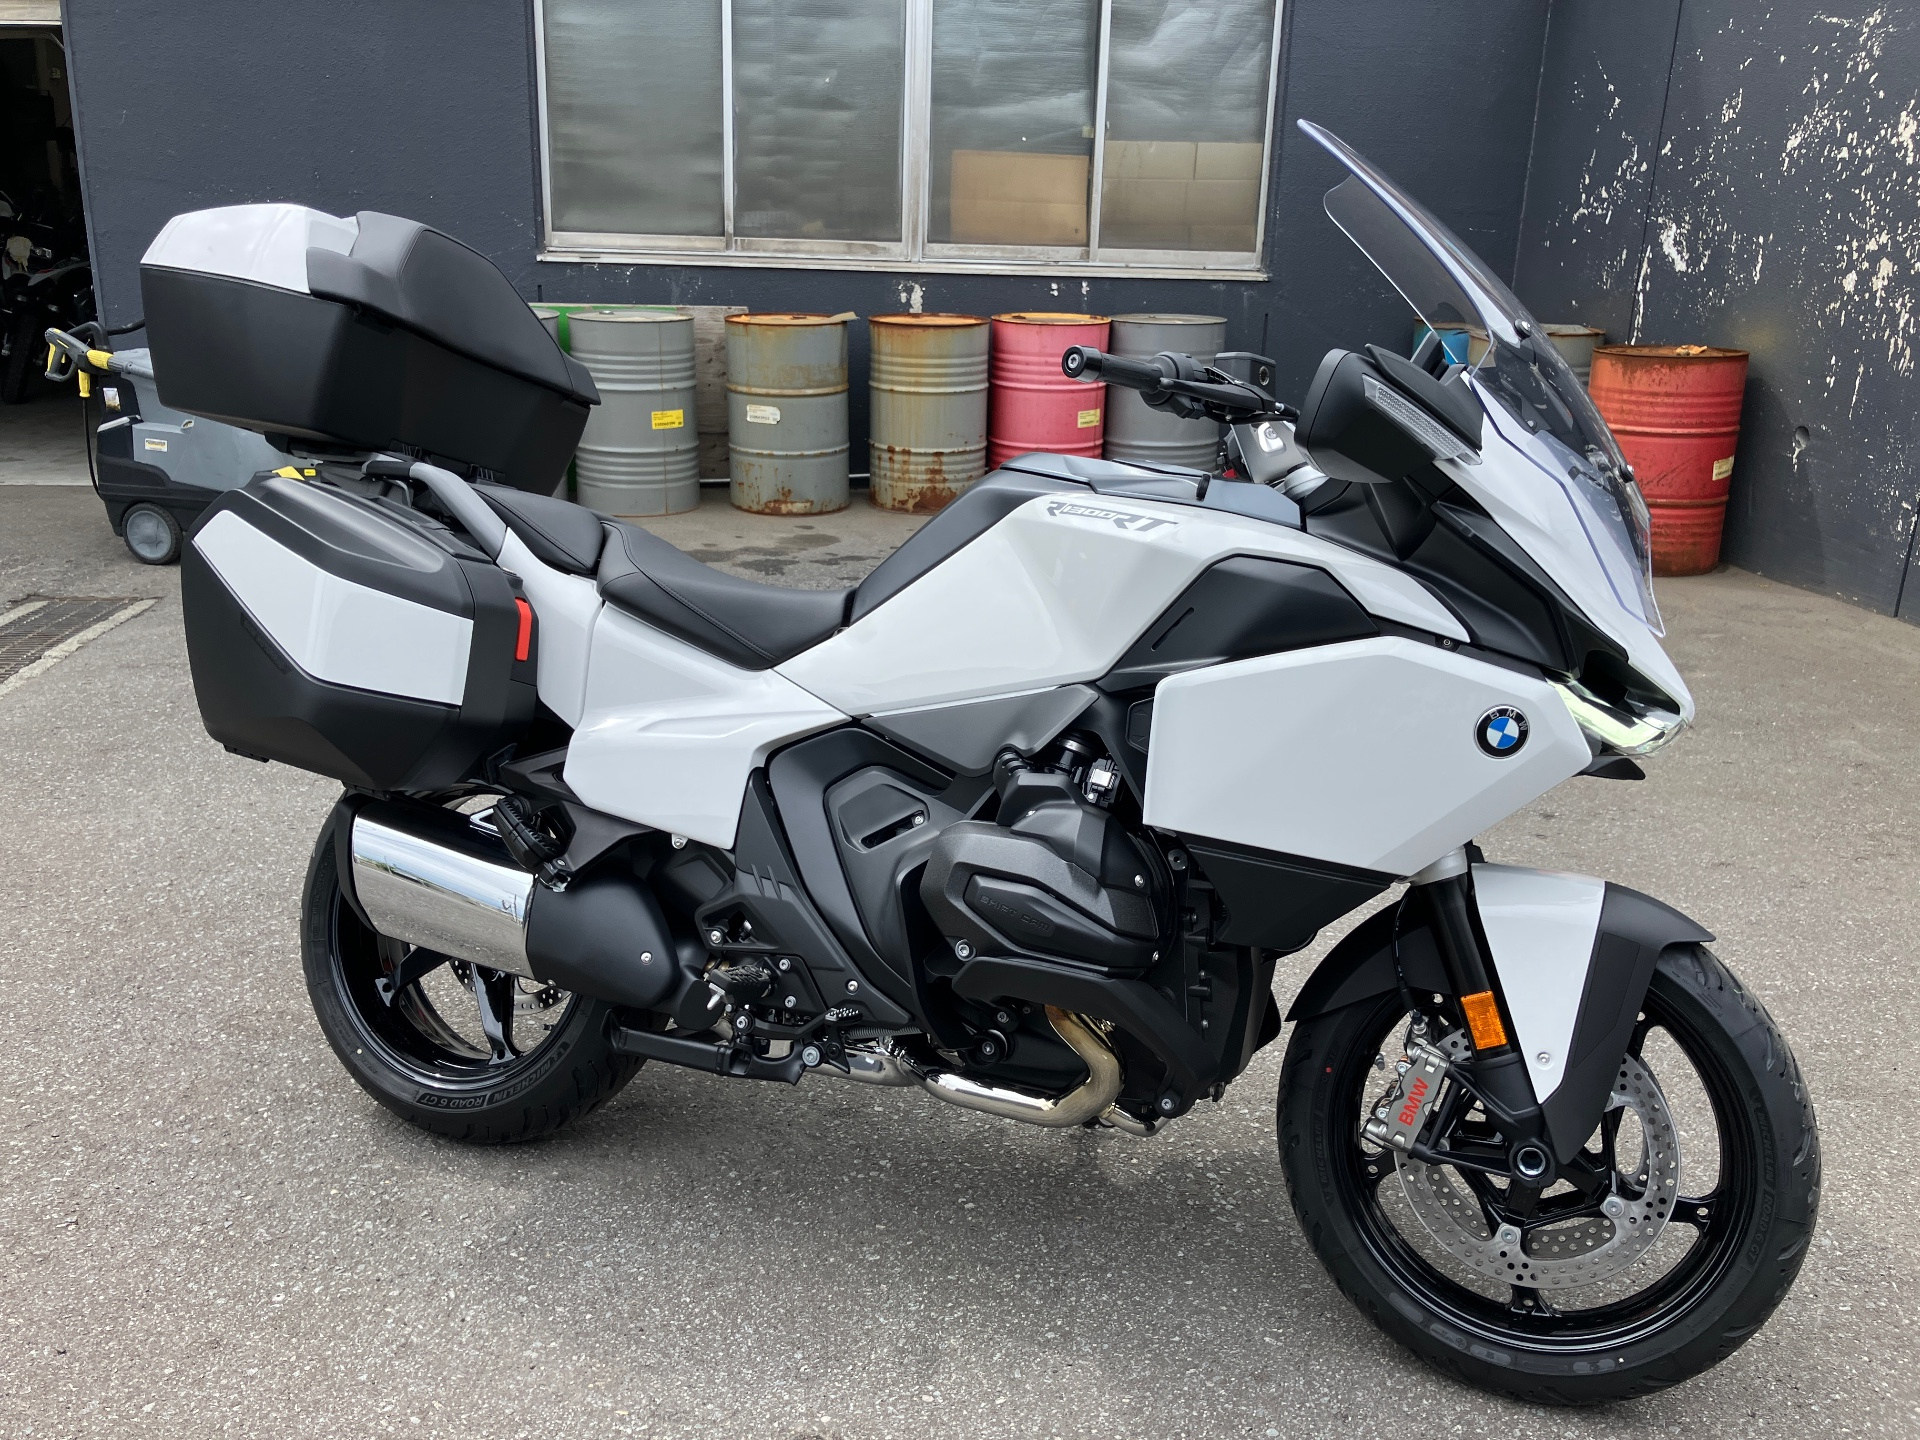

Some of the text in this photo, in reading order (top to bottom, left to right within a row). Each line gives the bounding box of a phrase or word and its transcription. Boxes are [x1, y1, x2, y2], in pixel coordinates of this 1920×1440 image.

[1489, 709, 1528, 731] BMW
[422, 1063, 551, 1108] MICHELIN ROAD 6 GT
[1398, 1077, 1429, 1126] BMW
[1314, 1119, 1328, 1183] MICHELIN
[1757, 1111, 1775, 1182] MICHELIN
[1760, 1193, 1775, 1231] ROAD
